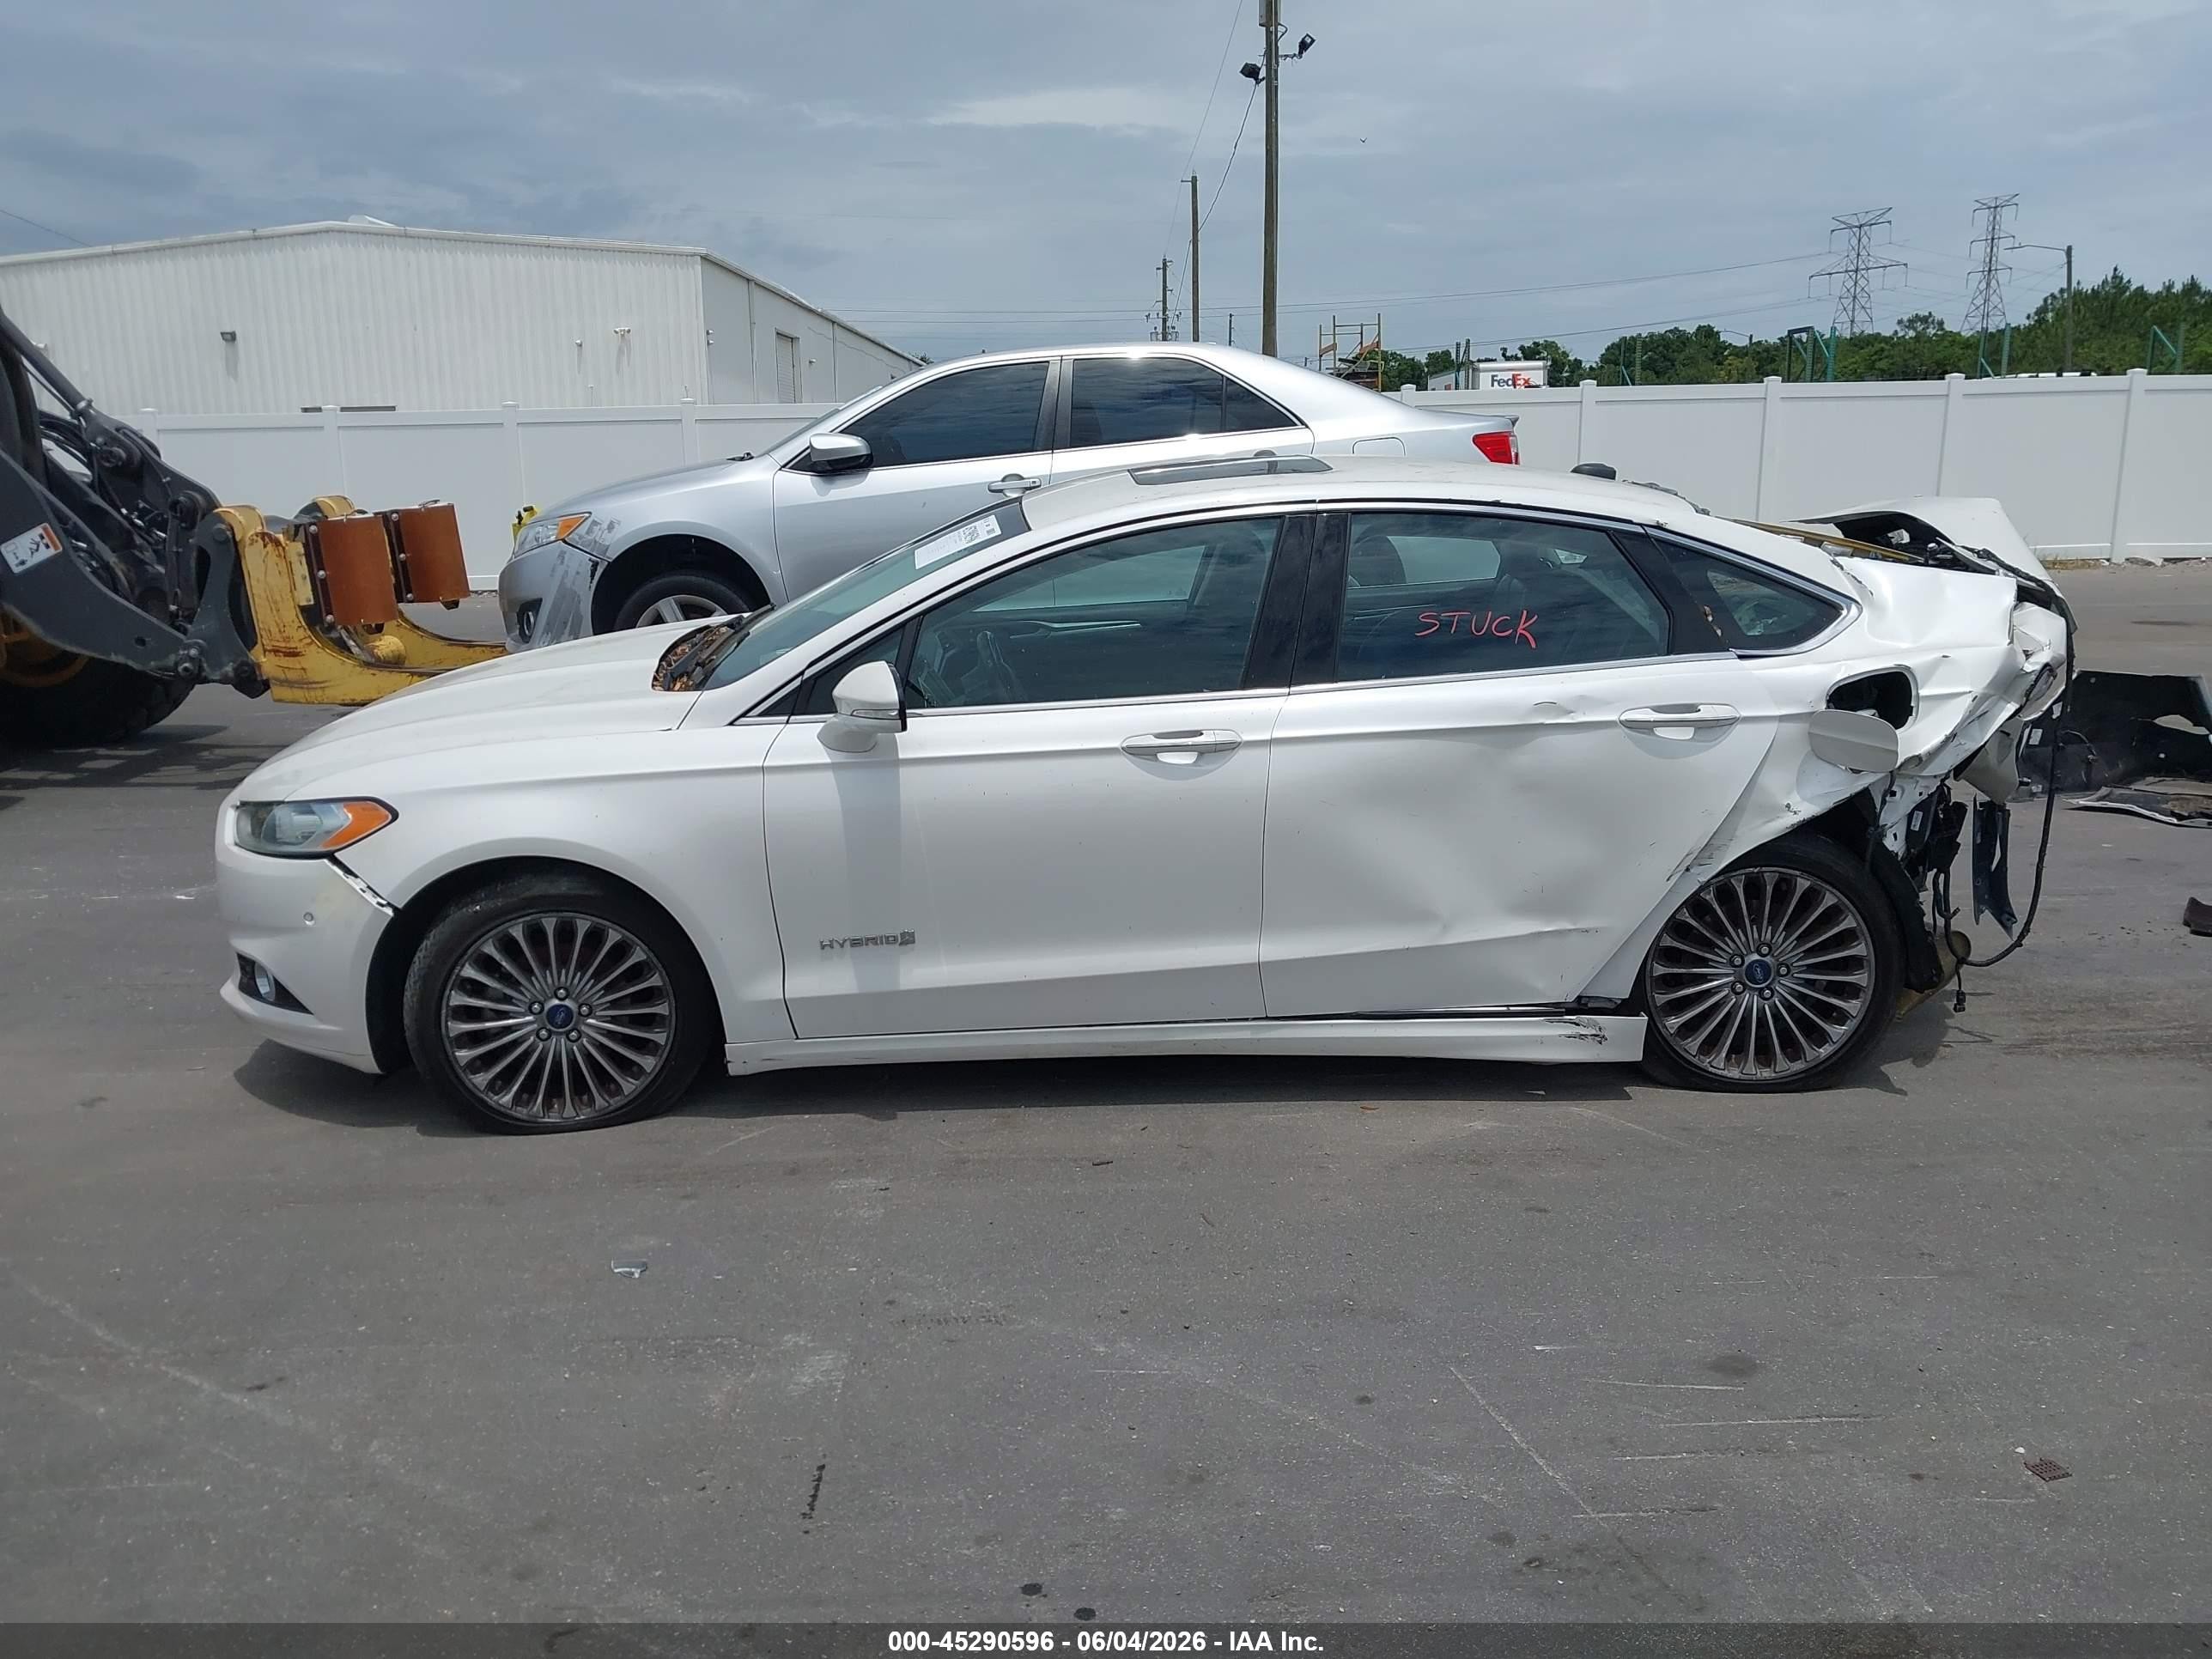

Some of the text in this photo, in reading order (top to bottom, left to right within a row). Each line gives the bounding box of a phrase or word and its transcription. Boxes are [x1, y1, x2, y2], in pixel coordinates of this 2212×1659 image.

[1491, 374, 1531, 388] FedEx
[1415, 610, 1538, 648] STUCK
[819, 933, 898, 950] HYBRID
